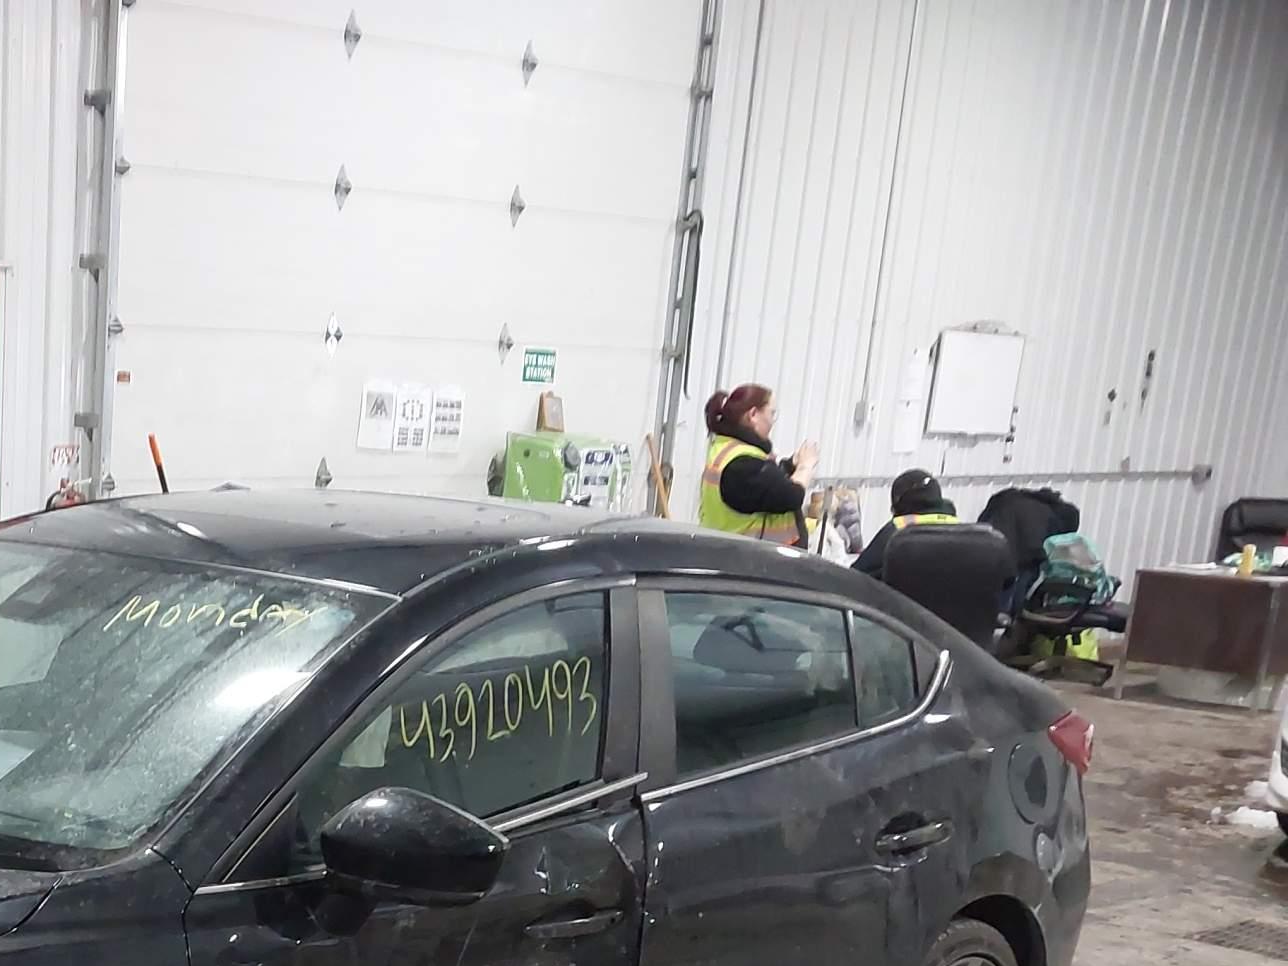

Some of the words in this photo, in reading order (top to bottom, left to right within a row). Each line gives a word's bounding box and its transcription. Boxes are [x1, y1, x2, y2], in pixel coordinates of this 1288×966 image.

[525, 354, 537, 367] EYE
[103, 594, 328, 638] Monday
[398, 656, 598, 764] 43920493
